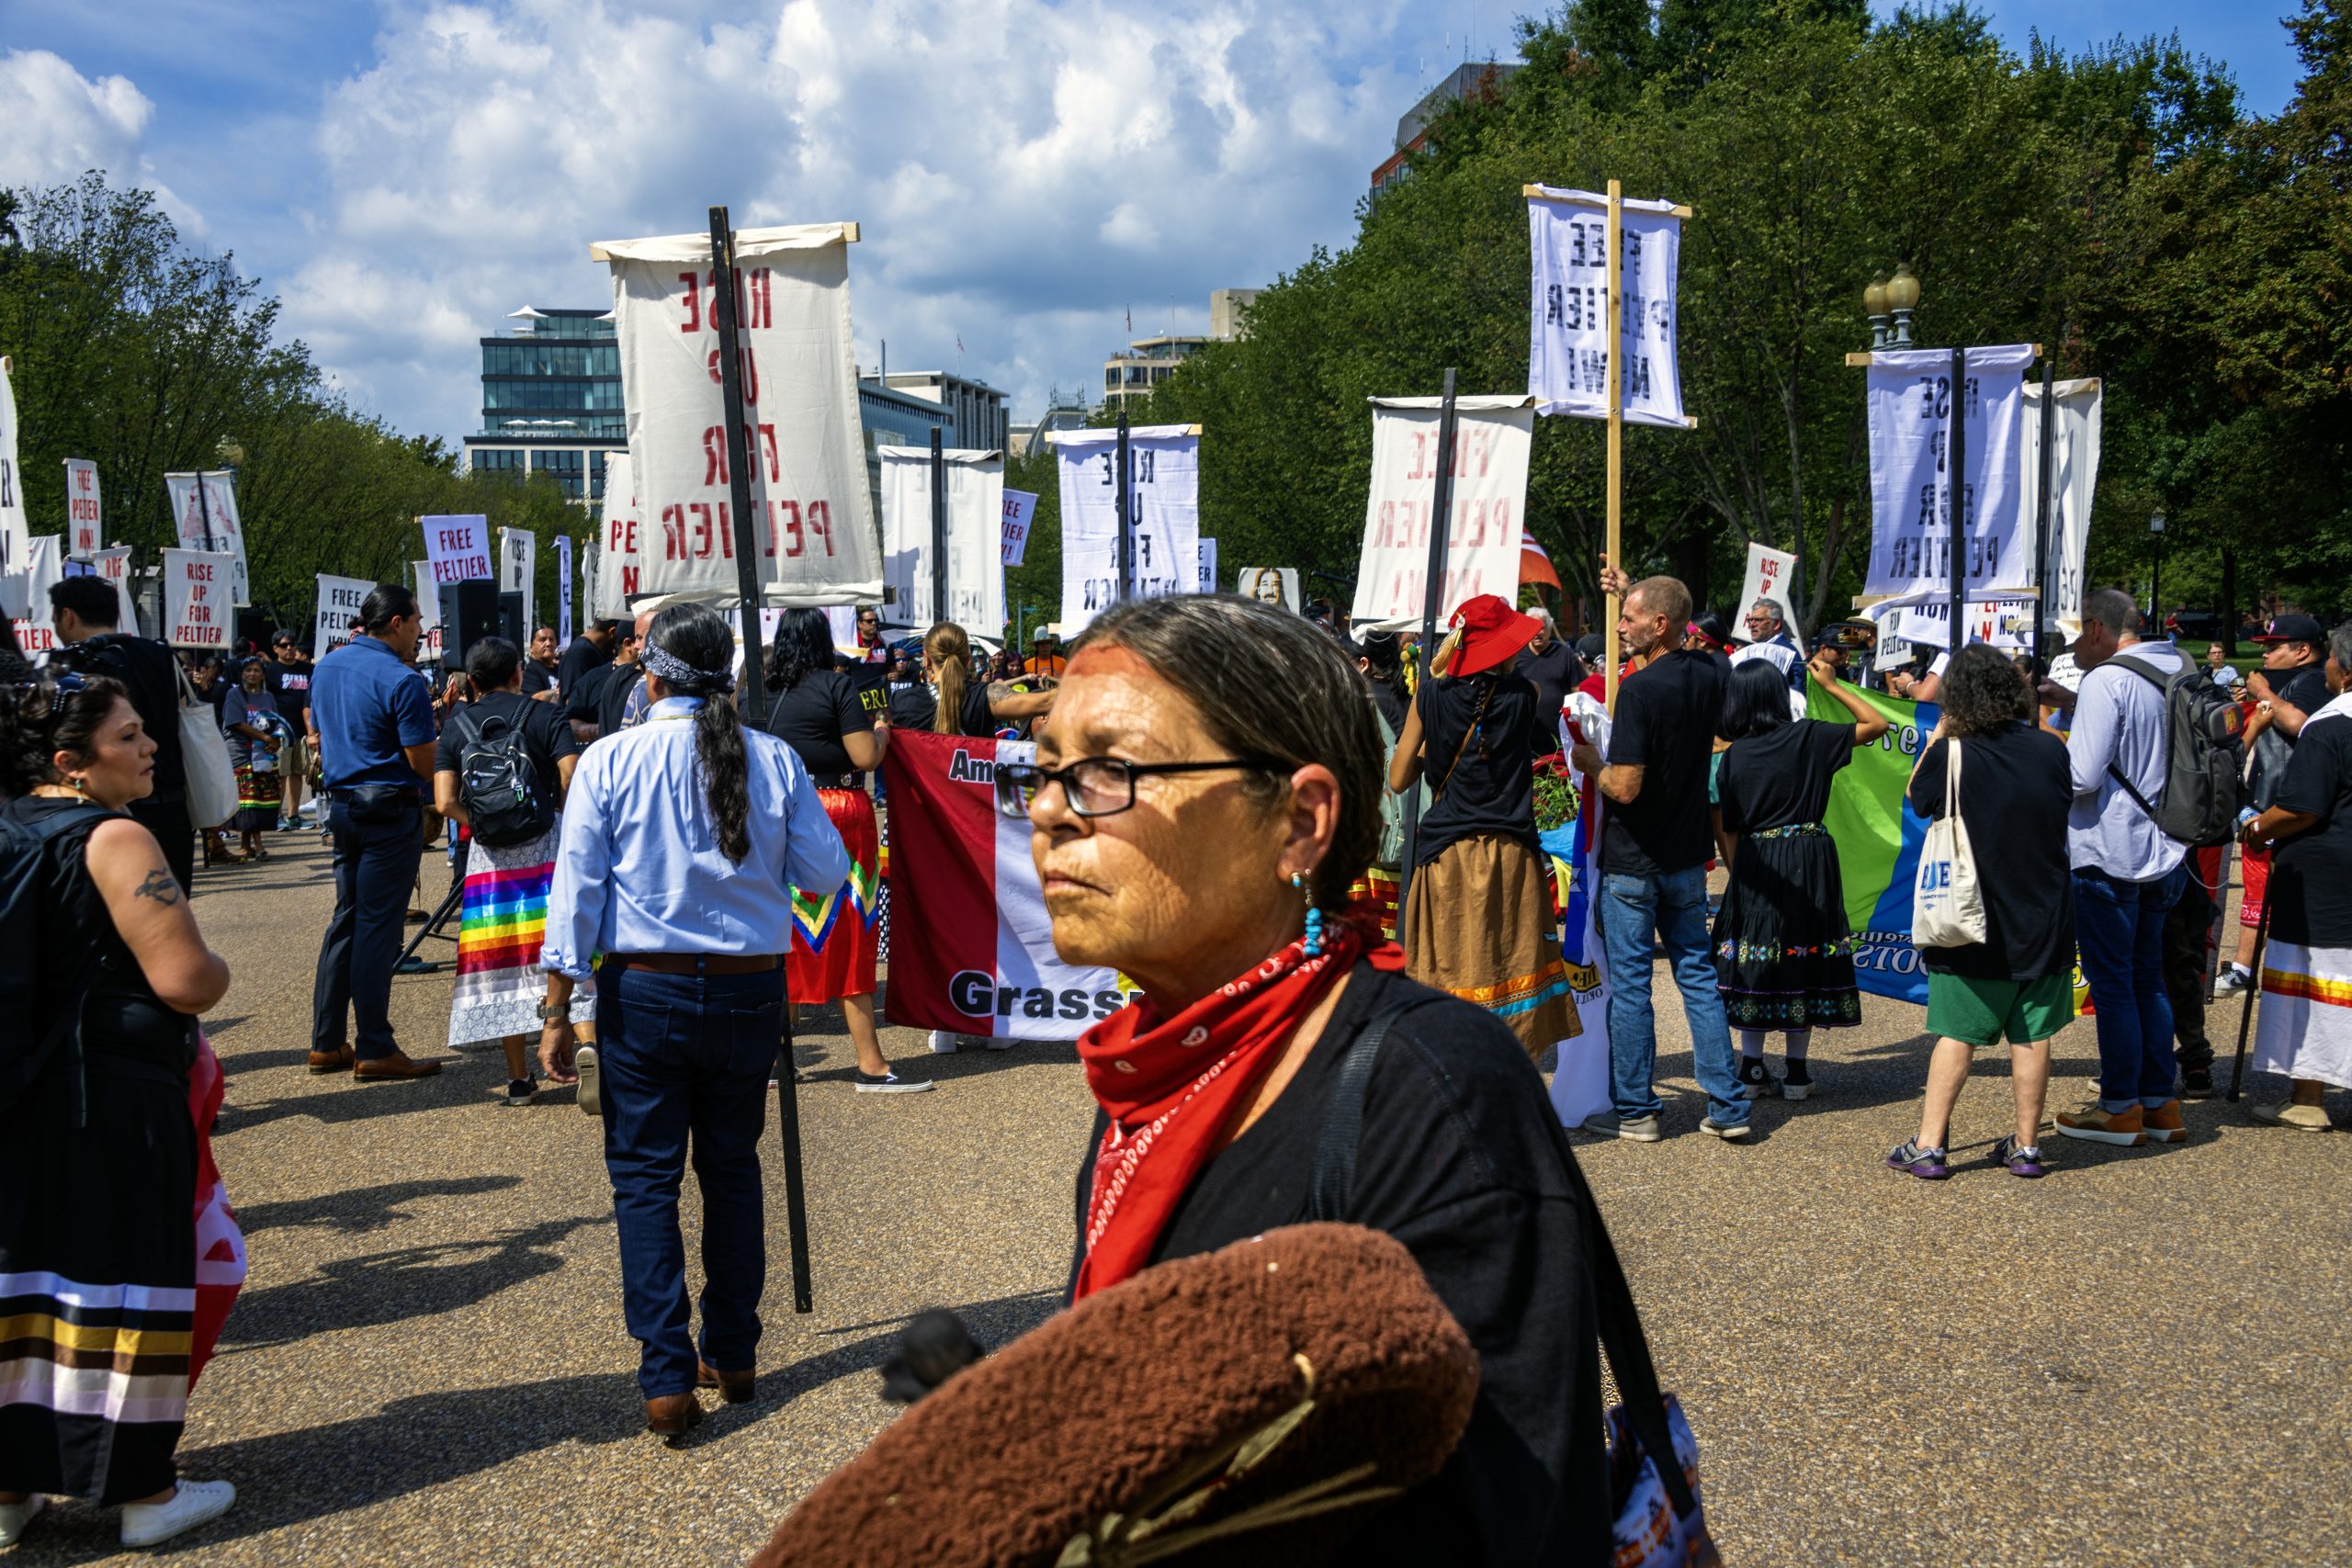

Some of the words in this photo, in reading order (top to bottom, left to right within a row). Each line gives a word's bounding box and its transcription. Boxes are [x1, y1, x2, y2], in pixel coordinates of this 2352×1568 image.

[439, 527, 473, 552] FREE
[187, 563, 213, 581] RISE
[434, 555, 488, 582] PELTIER
[1760, 558, 1780, 578] RISE
[192, 585, 207, 602] UP
[332, 588, 361, 608] FREE
[189, 605, 210, 623] FOR
[176, 626, 221, 644] PELTIER
[950, 970, 1146, 1021] Grass
